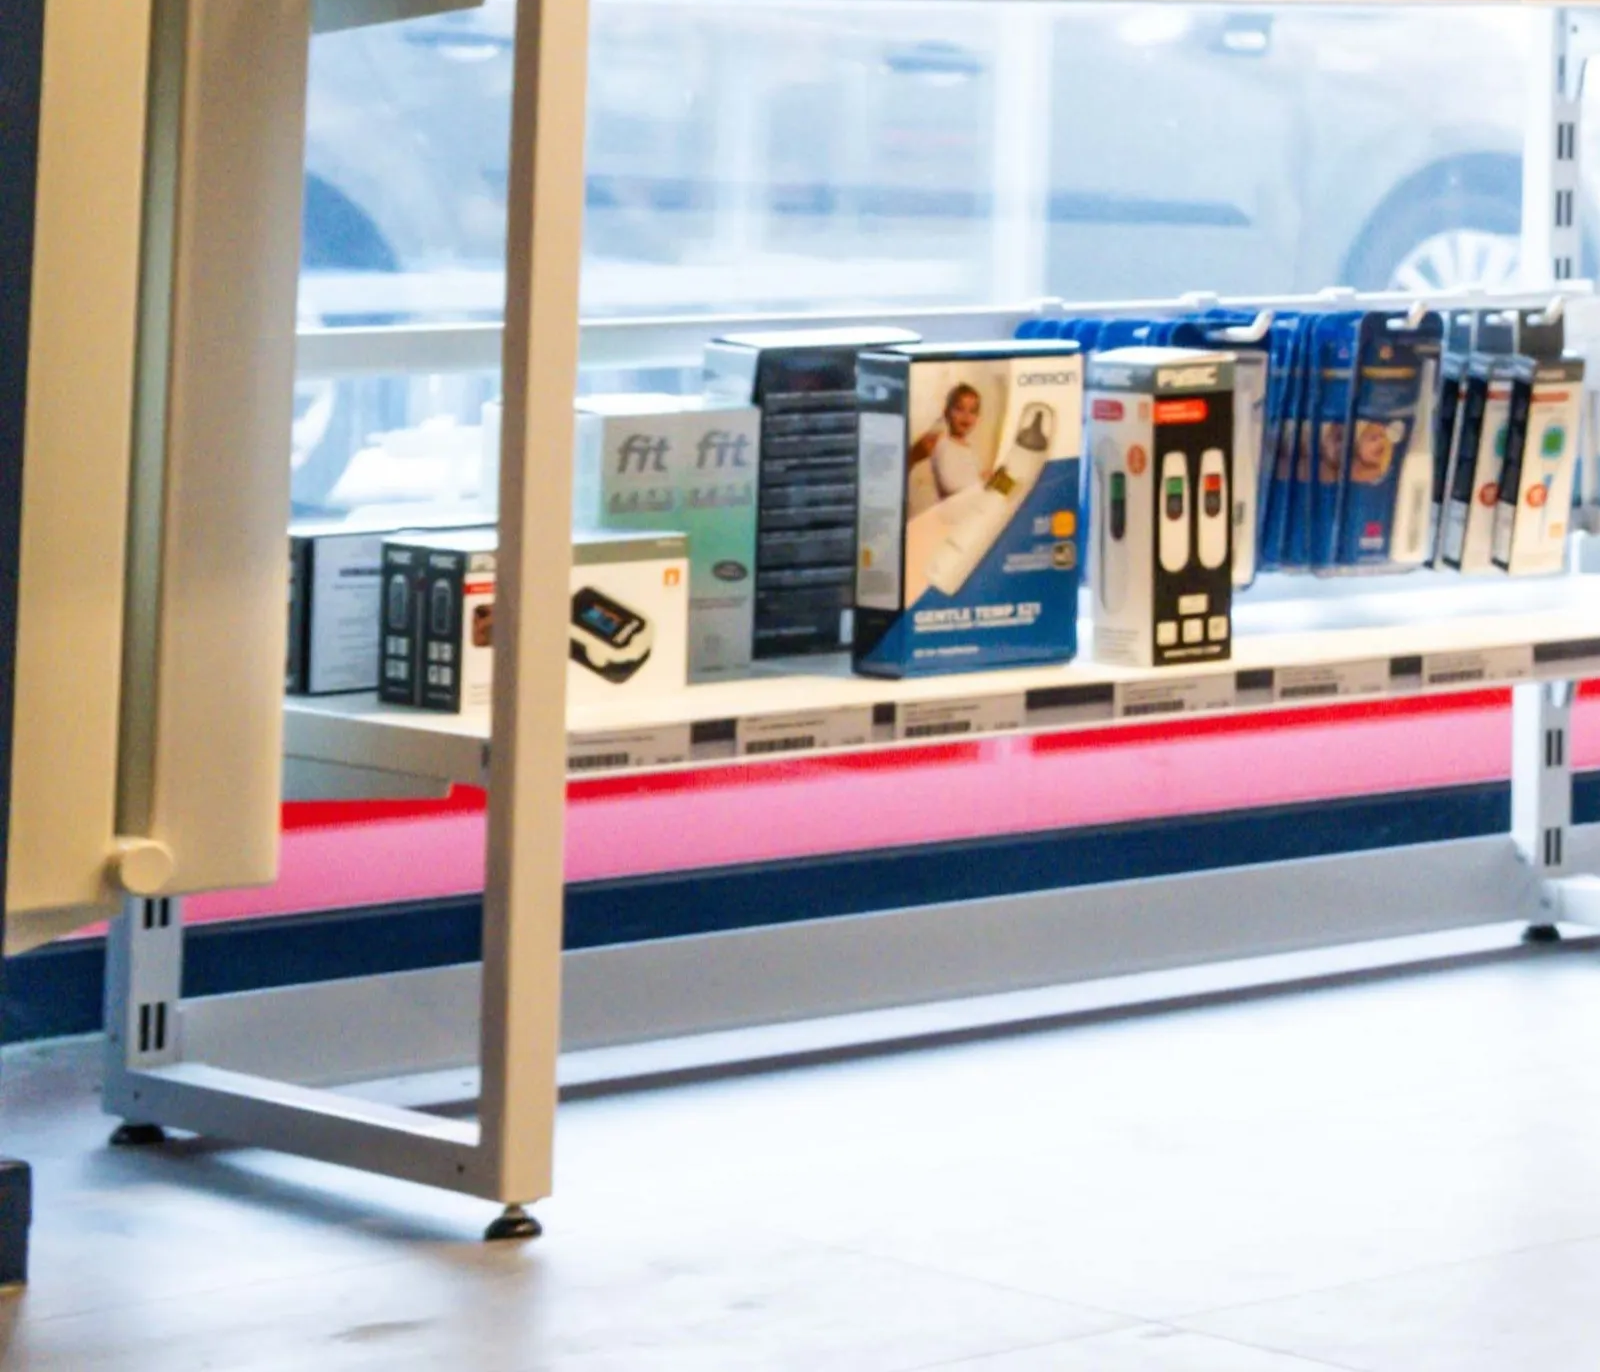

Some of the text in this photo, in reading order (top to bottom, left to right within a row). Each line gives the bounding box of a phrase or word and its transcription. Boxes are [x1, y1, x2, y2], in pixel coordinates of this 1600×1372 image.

[1017, 371, 1078, 388] OMRON
[617, 433, 672, 475] fit
[696, 429, 750, 470] fit
